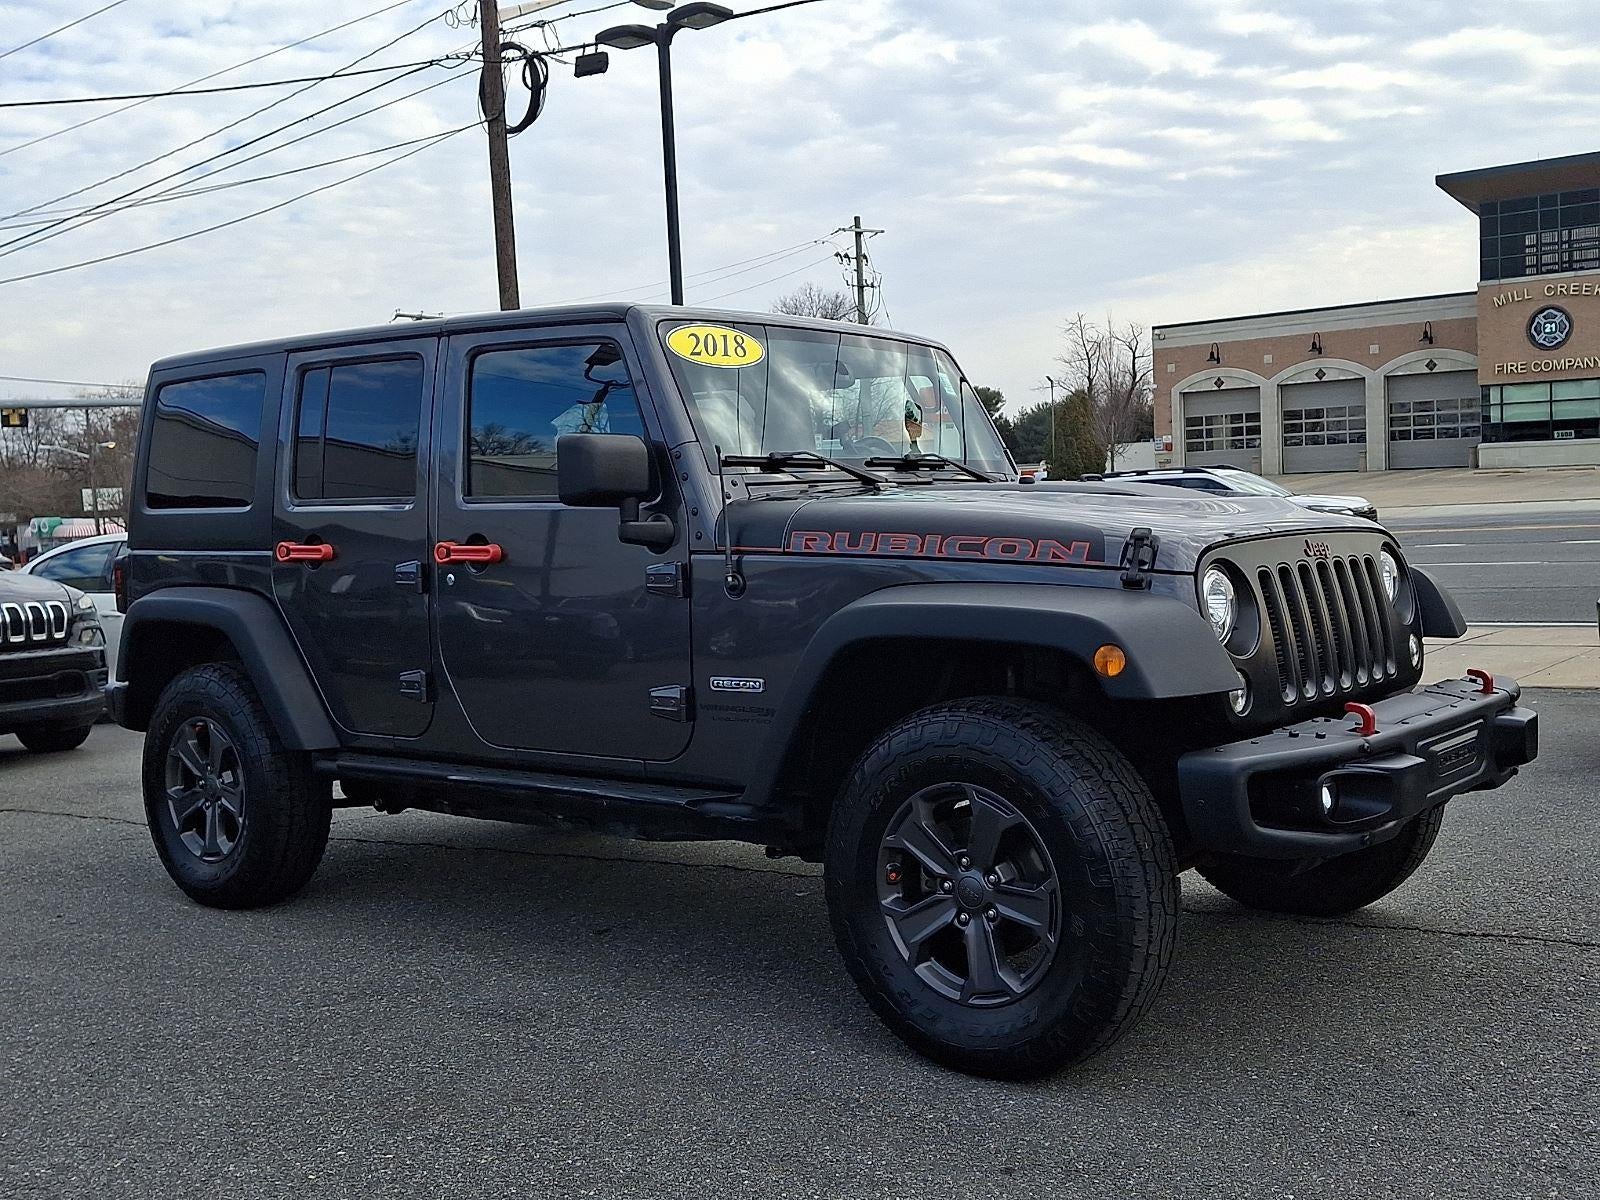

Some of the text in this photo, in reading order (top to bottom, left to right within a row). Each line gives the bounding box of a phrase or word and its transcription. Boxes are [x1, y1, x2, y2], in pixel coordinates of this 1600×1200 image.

[1493, 288, 1533, 308] MILL
[1544, 322, 1556, 333] 21
[687, 332, 747, 358] 2018
[1494, 361, 1528, 375] FIRE
[790, 531, 1092, 563] RUBICON
[1303, 539, 1330, 559] Jeep
[713, 680, 760, 689] RECON
